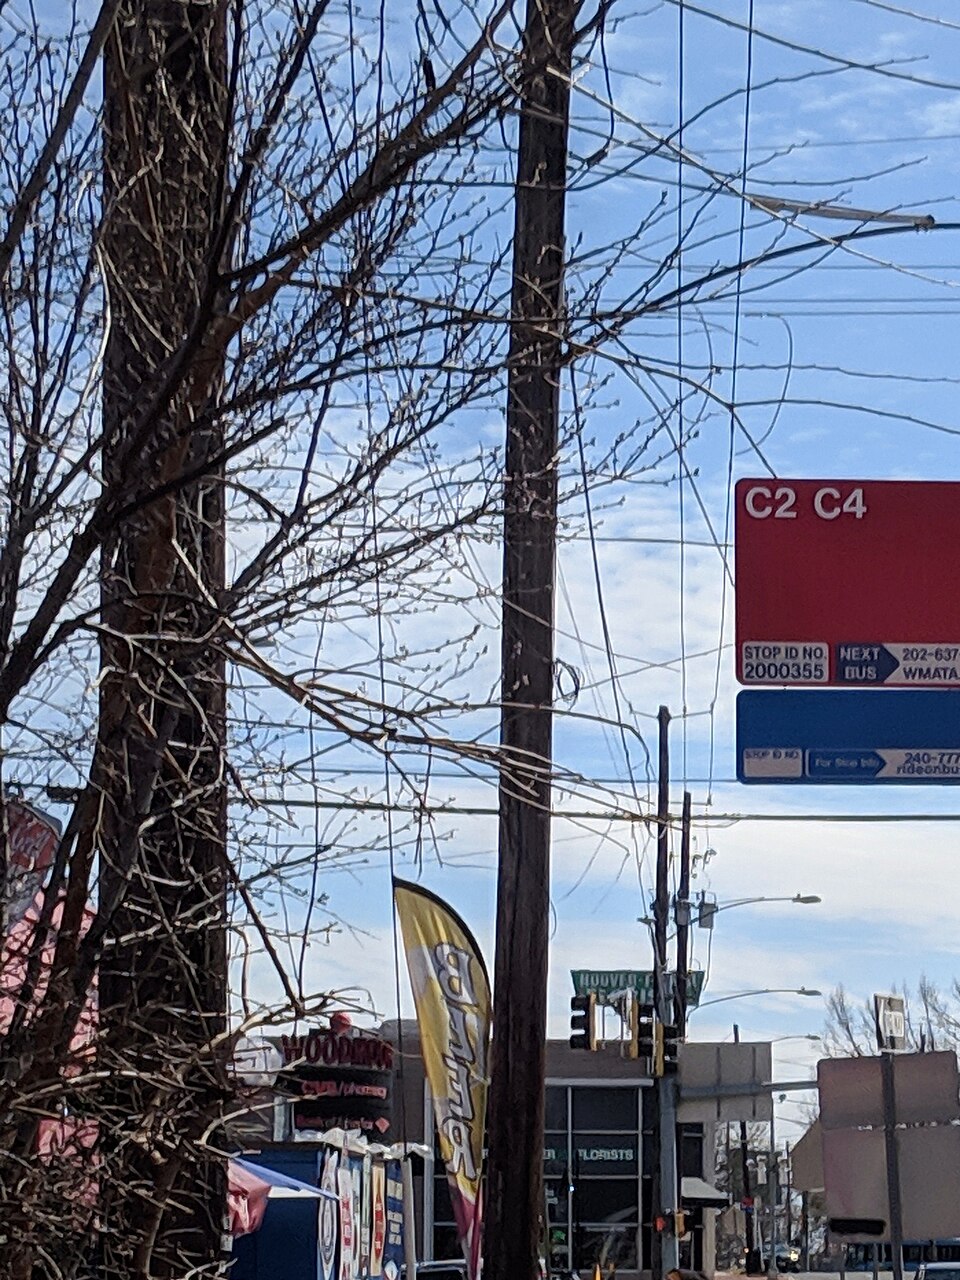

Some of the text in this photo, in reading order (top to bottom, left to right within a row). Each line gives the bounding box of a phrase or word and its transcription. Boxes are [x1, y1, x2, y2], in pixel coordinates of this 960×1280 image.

[745, 486, 868, 520] C2 C4
[744, 645, 827, 660] STOP ID NO.
[839, 646, 880, 660] NEXT
[744, 662, 825, 679] 2000355
[844, 665, 877, 680] BUS
